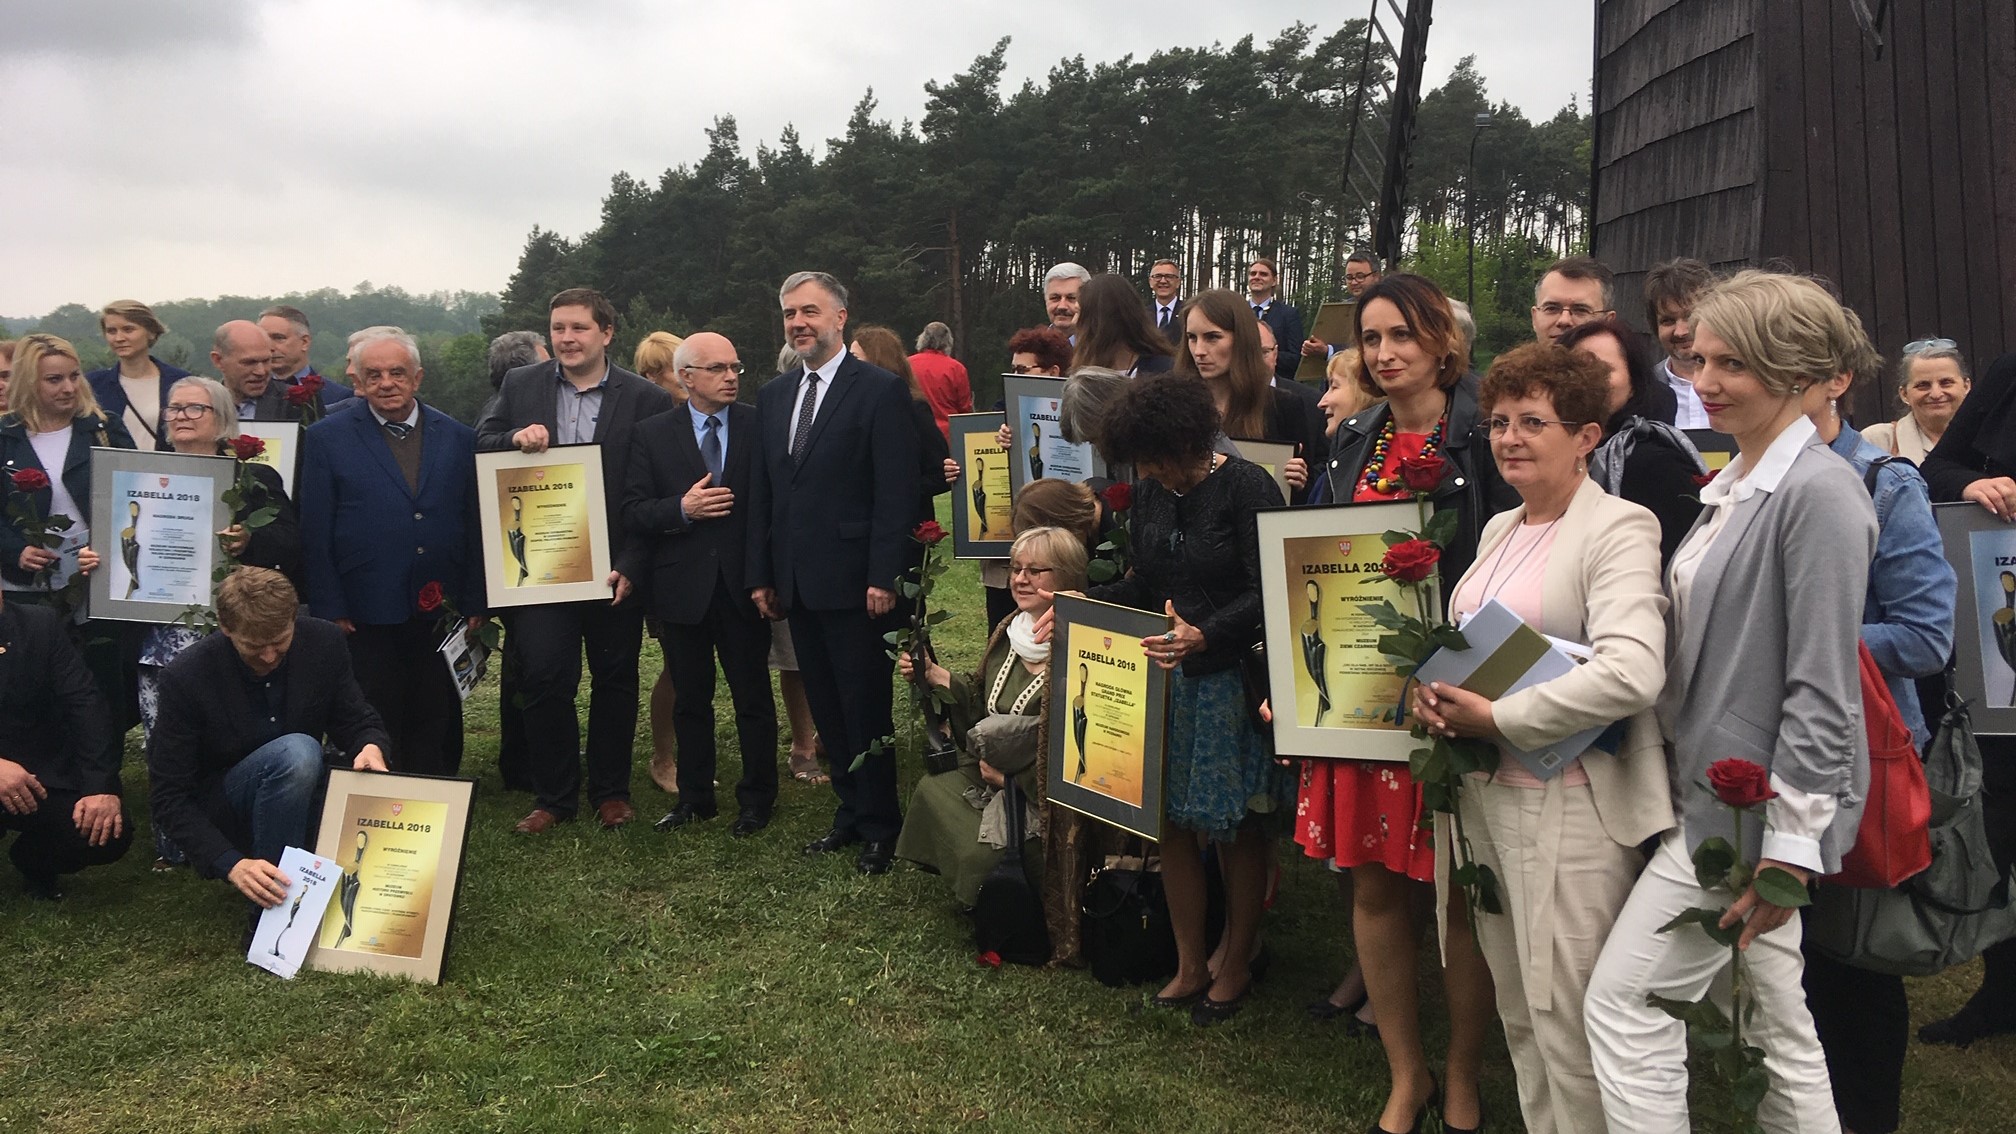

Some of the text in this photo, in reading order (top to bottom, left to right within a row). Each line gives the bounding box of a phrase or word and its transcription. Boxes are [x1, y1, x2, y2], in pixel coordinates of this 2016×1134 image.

[508, 482, 574, 493] IZABELLA 2018
[127, 490, 200, 502] IZABELLA 2018
[1302, 563, 1360, 574] IZABELLA
[1078, 649, 1136, 671] IZABELLA 2018
[357, 818, 431, 833] IZABELLA 2018
[299, 866, 326, 882] IZABELLA
[302, 876, 317, 886] 2018
